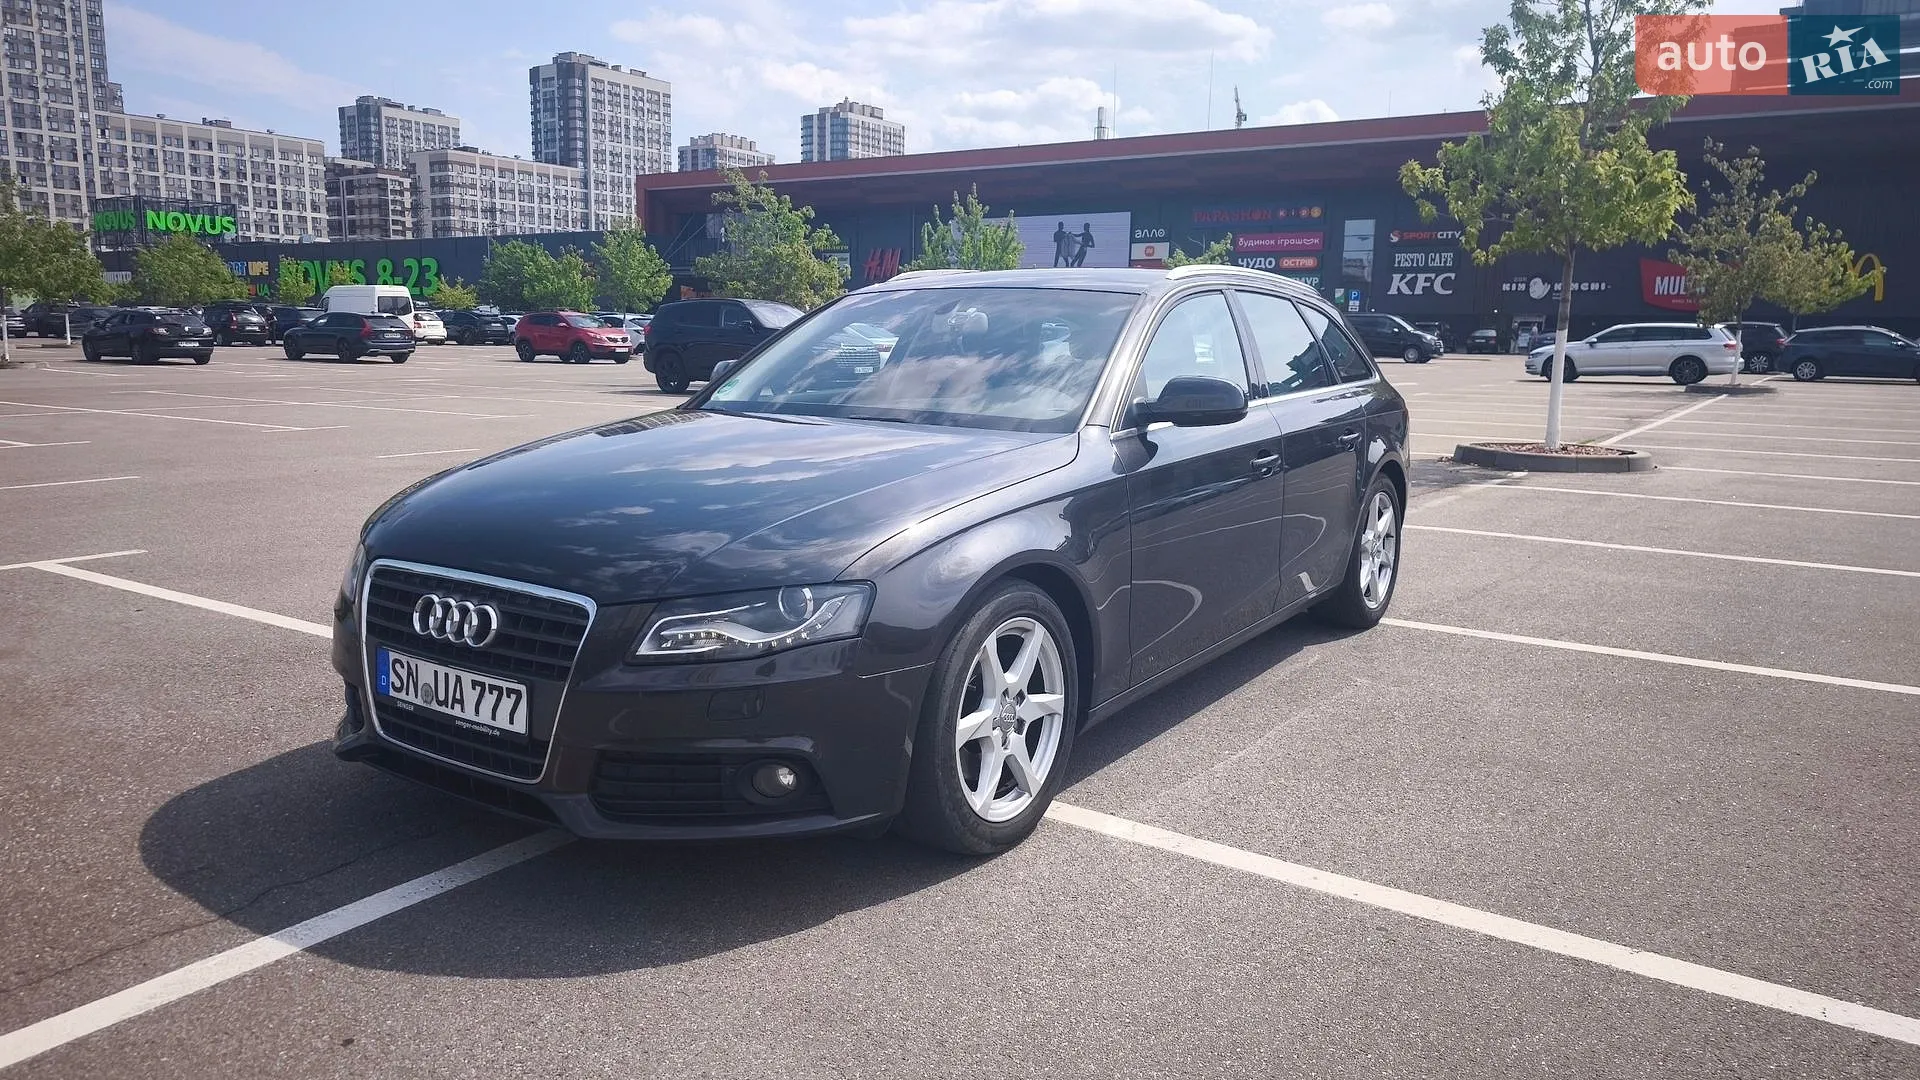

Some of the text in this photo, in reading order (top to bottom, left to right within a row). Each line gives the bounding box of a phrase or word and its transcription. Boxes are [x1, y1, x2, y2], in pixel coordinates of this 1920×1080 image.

[95, 209, 136, 232] NOVUS
[145, 209, 237, 235] NOVUS
[1238, 237, 1275, 247] будинок
[1238, 257, 1276, 269] ЧУДО
[1394, 252, 1454, 267] PESTO CAFE
[376, 257, 438, 296] 8-23
[1387, 272, 1456, 295] KFC
[1553, 282, 1606, 292] KMCHI
[381, 675, 387, 686] D
[390, 657, 523, 726] SN UA 777
[455, 719, 500, 737] senger-mobility.de
